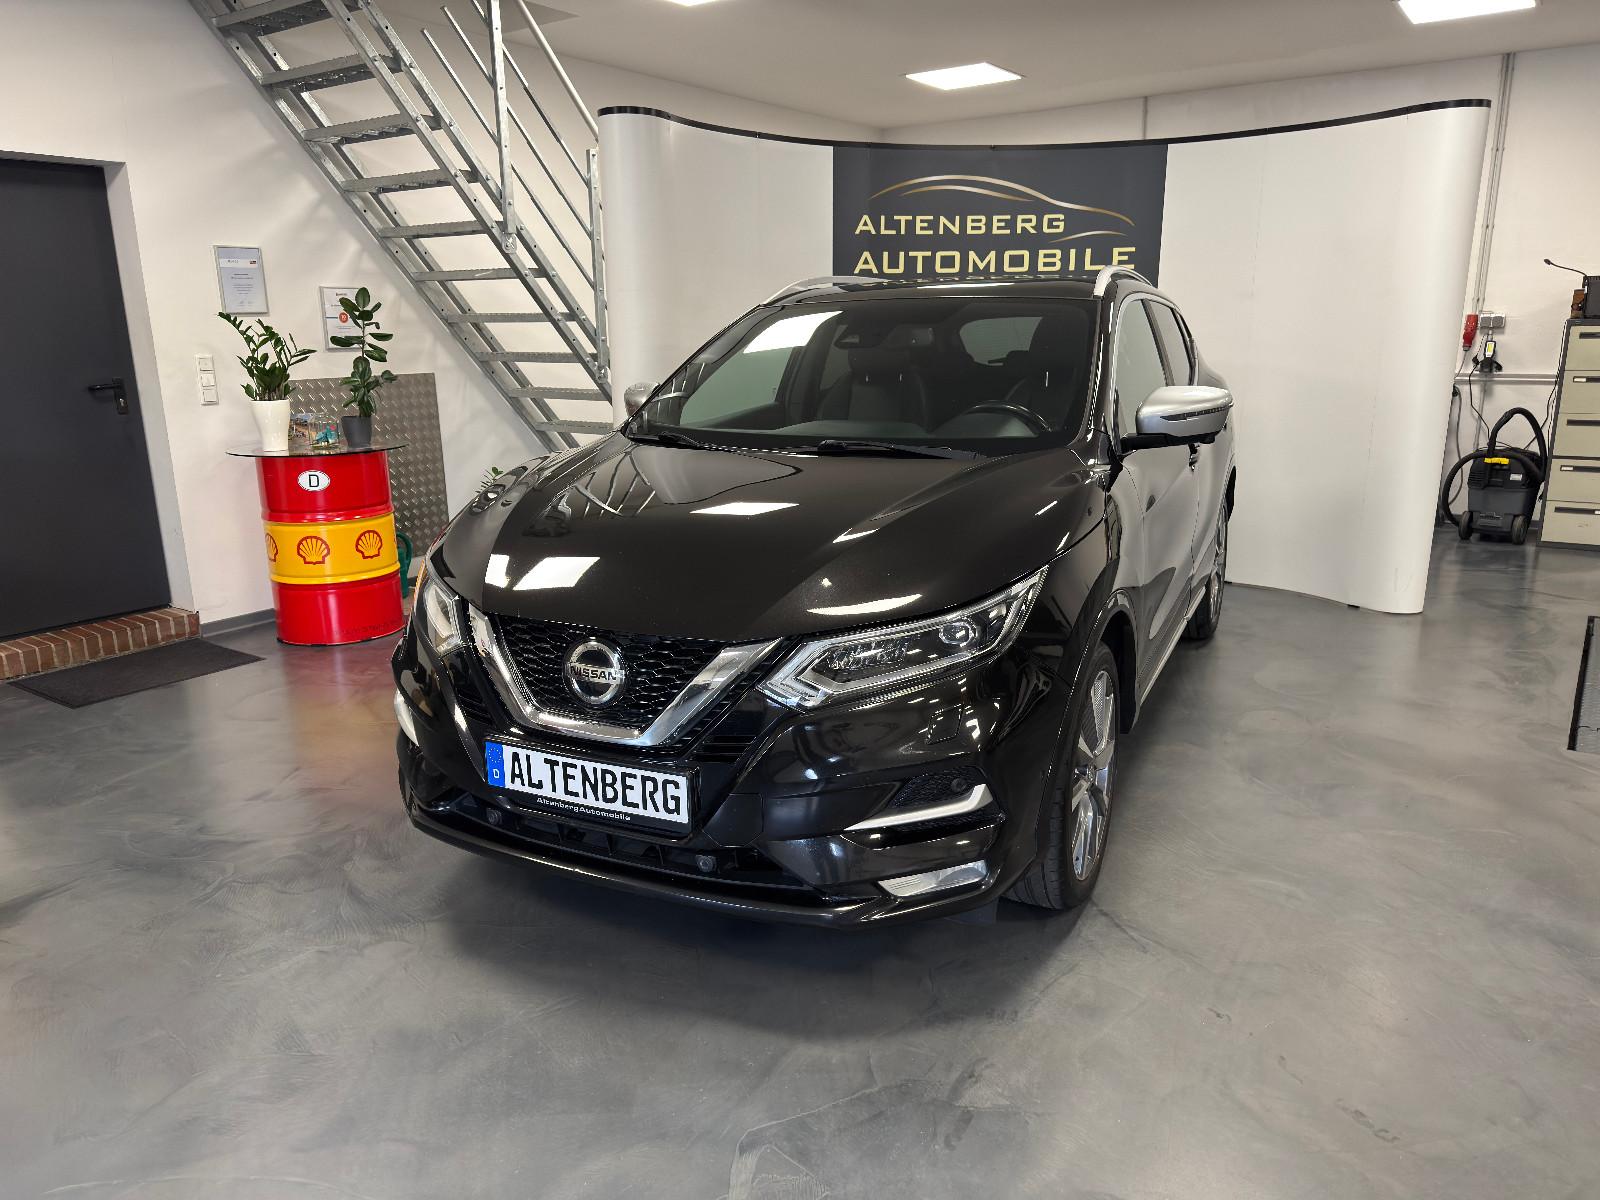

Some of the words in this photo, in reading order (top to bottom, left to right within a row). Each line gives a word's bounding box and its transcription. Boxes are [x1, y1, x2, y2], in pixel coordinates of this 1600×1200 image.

[855, 214, 1065, 235] ALTENBERG
[854, 247, 1136, 274] AUTOMOBILE
[308, 474, 320, 487] D
[570, 666, 617, 681] NISSAN
[493, 768, 500, 779] D
[511, 751, 681, 816] ALTENBERG
